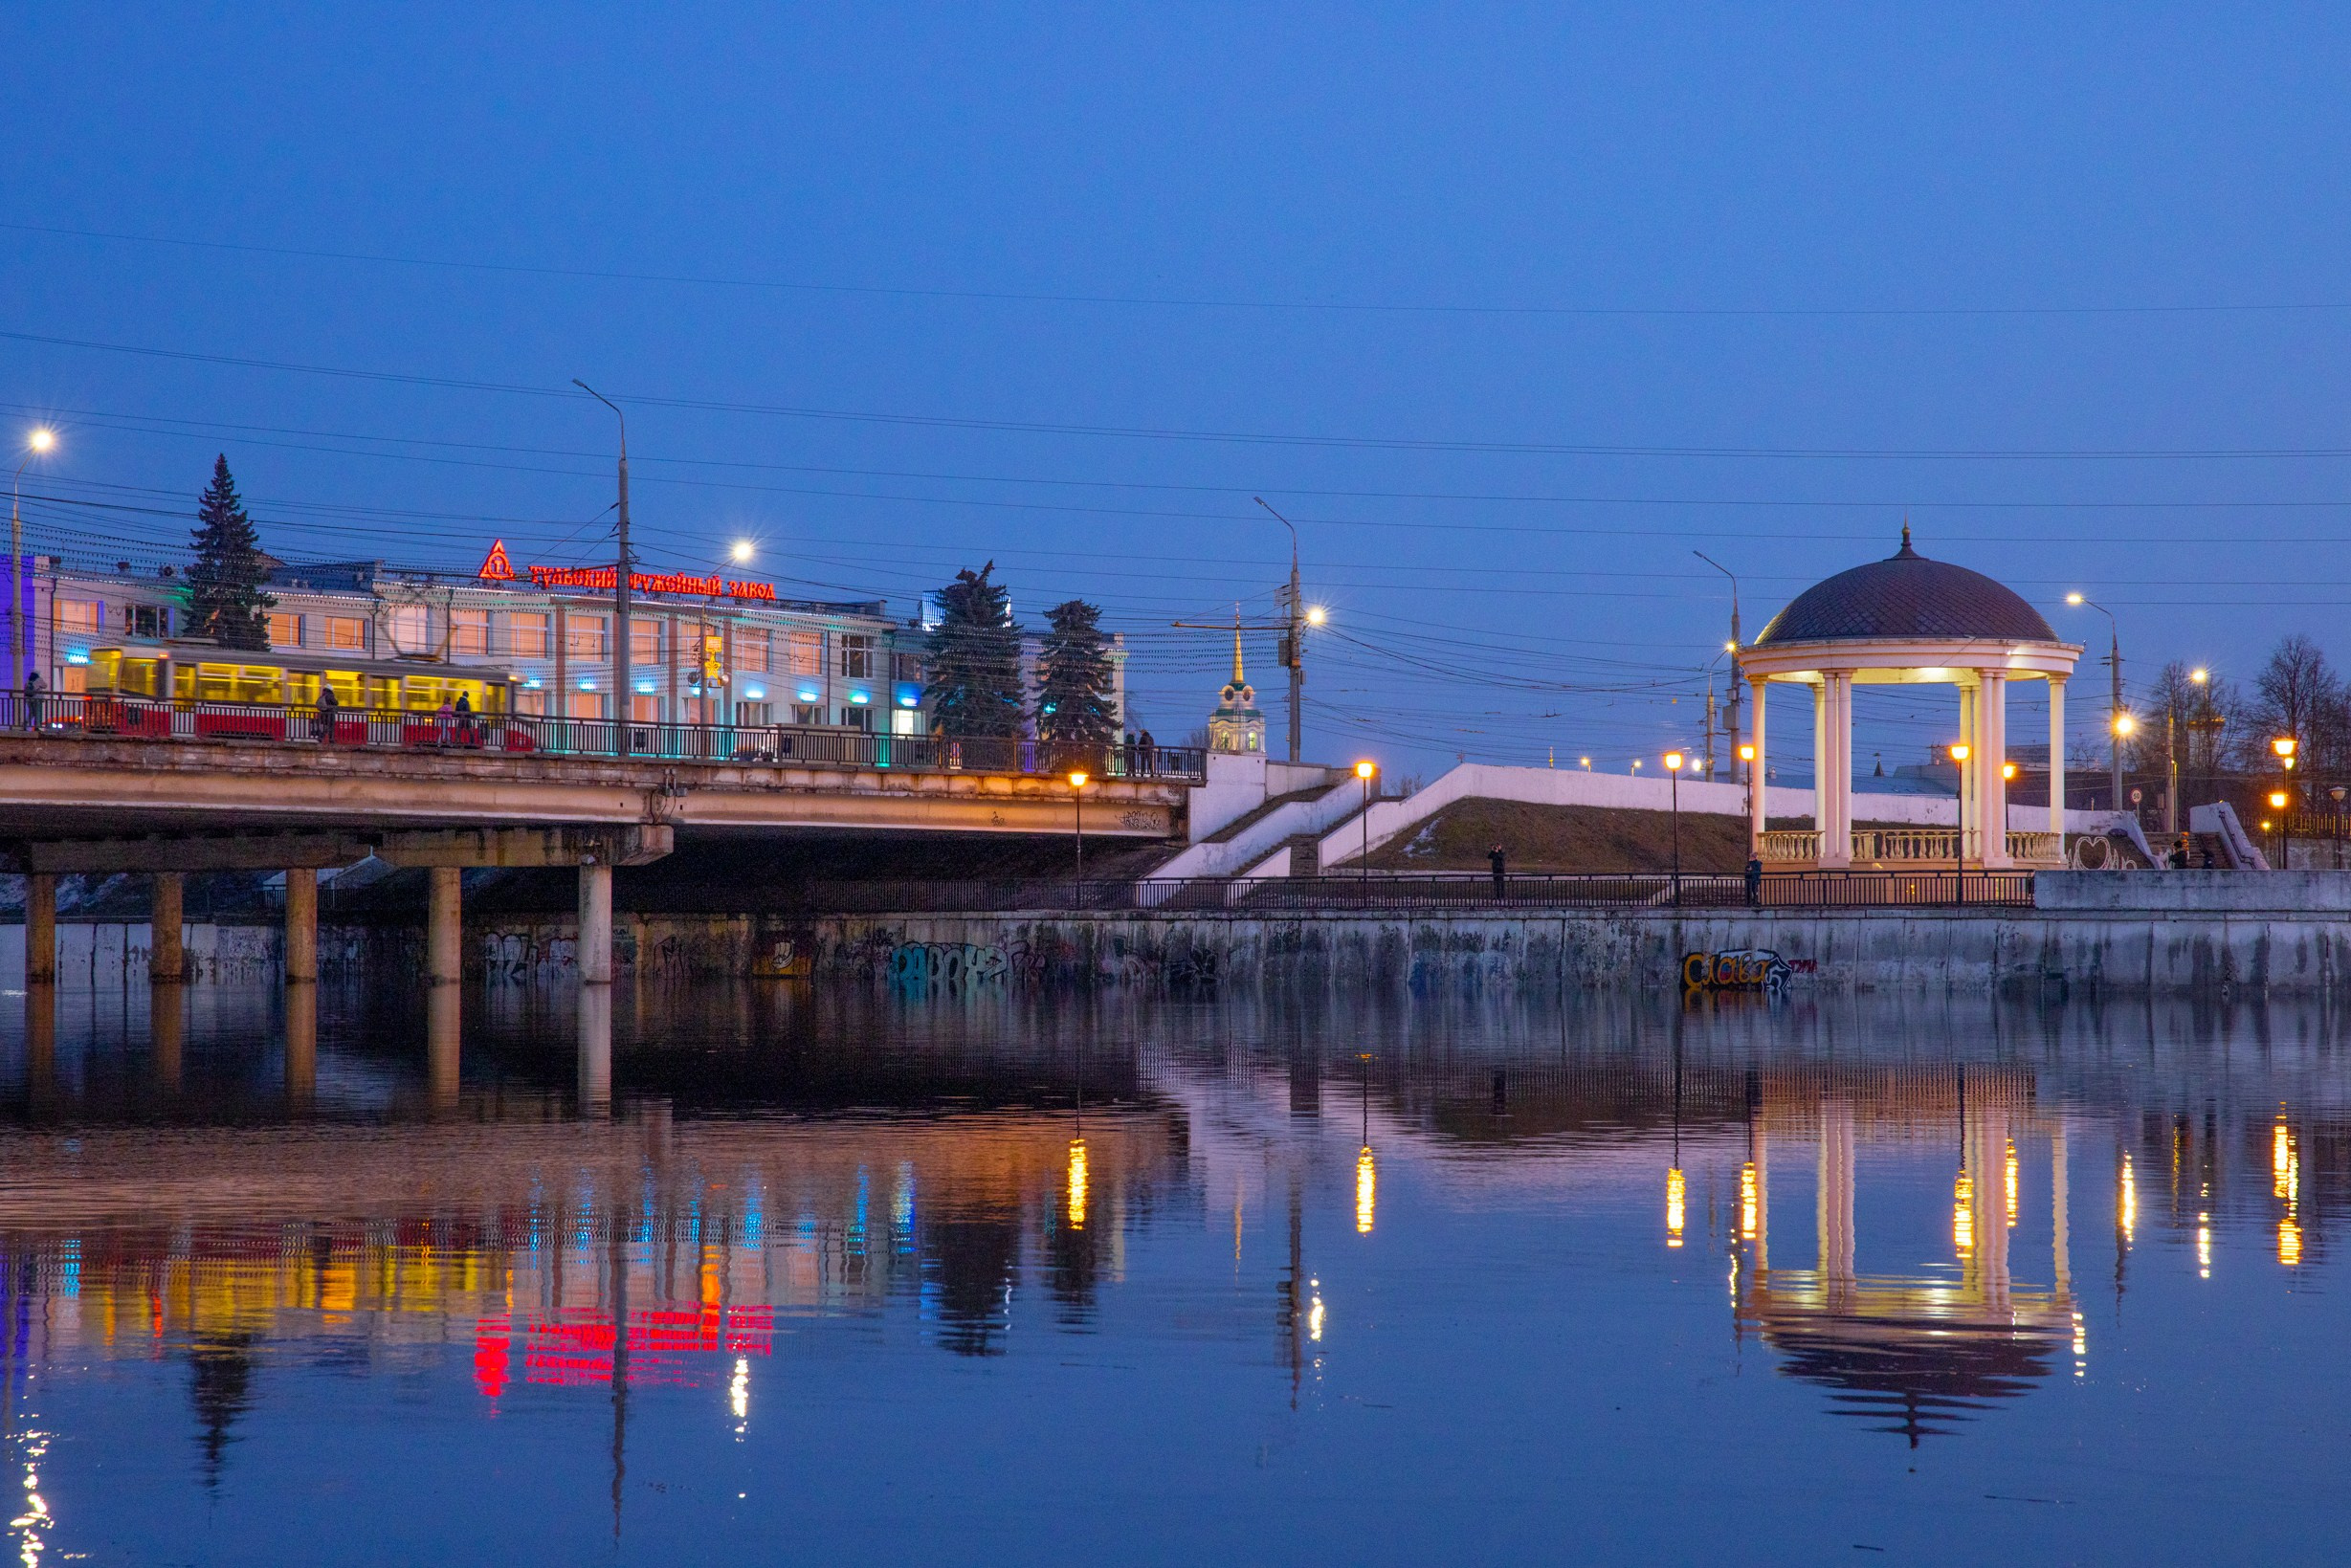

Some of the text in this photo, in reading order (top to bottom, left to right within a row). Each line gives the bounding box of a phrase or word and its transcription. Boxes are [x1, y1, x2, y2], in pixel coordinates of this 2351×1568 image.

[528, 565, 618, 588] ТУЛЬСКИЙ
[727, 580, 777, 601] ЗАВОД
[1683, 953, 1769, 987] Слава
